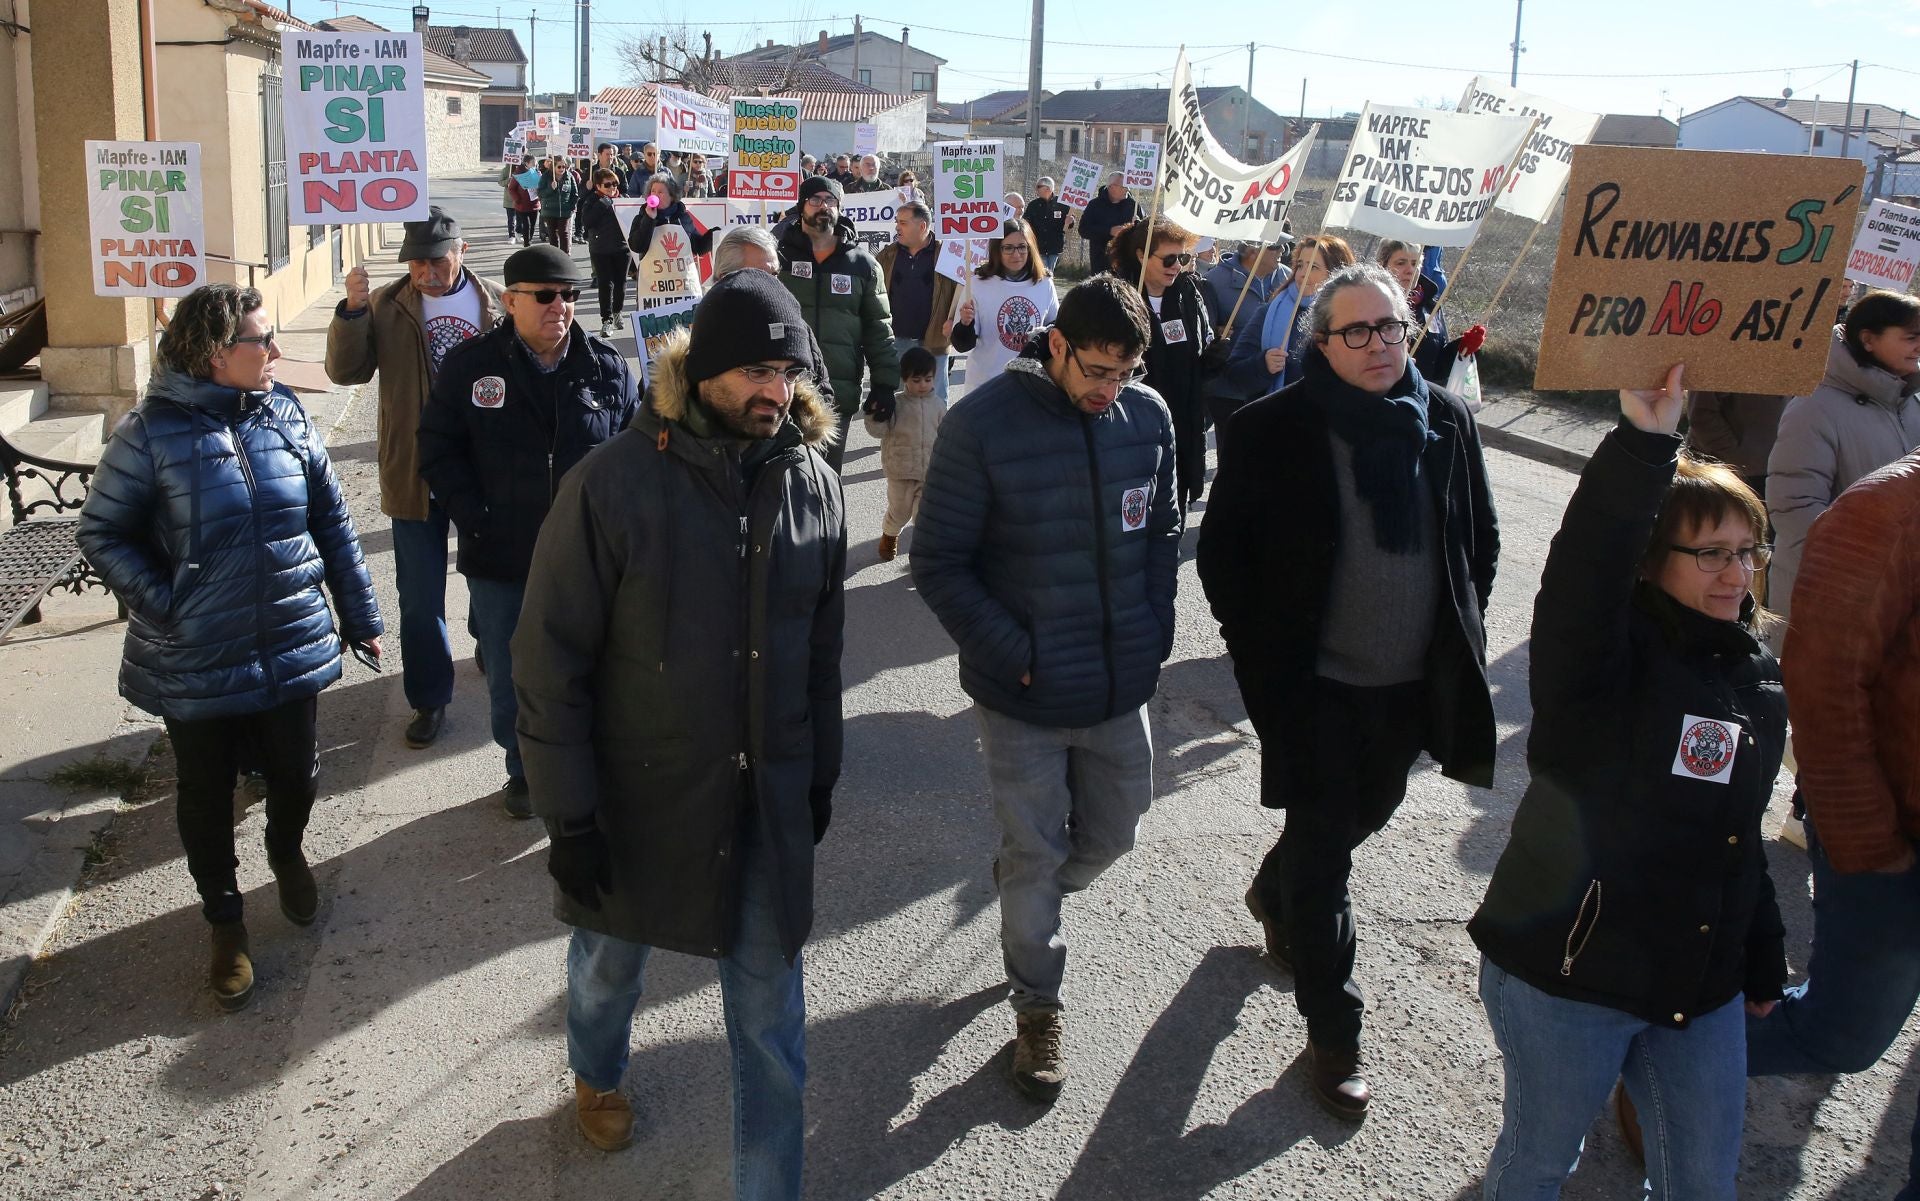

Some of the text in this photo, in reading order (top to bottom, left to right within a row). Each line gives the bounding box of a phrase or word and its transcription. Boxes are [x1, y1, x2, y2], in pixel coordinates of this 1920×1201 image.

[297, 38, 360, 62] Mapfre
[375, 39, 407, 59] IAM
[300, 65, 406, 92] PINAR
[590, 106, 608, 114] STOP
[661, 105, 696, 131] NO
[734, 100, 797, 119] Nuestro
[735, 114, 797, 133] pueblo
[1367, 113, 1430, 138] MAPFRE
[733, 133, 796, 154] Nuestro
[941, 146, 972, 158] Mapfre
[979, 145, 996, 155] IAM
[97, 148, 148, 167] Mapfre
[160, 149, 187, 165] IAM
[299, 150, 418, 174] PLANTA
[738, 149, 790, 171] hogar
[1130, 149, 1155, 158] PINAR
[942, 157, 995, 173] PINAR
[1071, 166, 1097, 178] PINAR
[1127, 169, 1154, 178] PLANTA
[100, 169, 187, 192] PINAR
[735, 172, 793, 190] NO
[1126, 176, 1152, 187] NO
[1241, 164, 1291, 204] NO
[1347, 154, 1474, 196] PINAREJOS
[303, 178, 418, 214] NO
[742, 188, 758, 197] planta
[759, 188, 766, 196] de
[1061, 192, 1088, 207] NO
[1064, 185, 1091, 198] PLANTA
[1181, 184, 1204, 217] TU
[1332, 182, 1359, 202] ES
[1364, 185, 1432, 220] LUGAR
[841, 206, 897, 222] EBLO
[941, 201, 999, 214] PLANTA
[1879, 208, 1920, 226] Planta de
[942, 215, 999, 234] NO
[100, 239, 197, 257] PLANTA
[103, 260, 197, 288] NO
[1848, 249, 1916, 283] DESPOBLACIÓN
[1568, 293, 1646, 337] PERO
[1648, 280, 1724, 336] NO
[1683, 722, 1732, 753] PLATAFORMA PINAREJOS
[1696, 761, 1712, 770] NO
